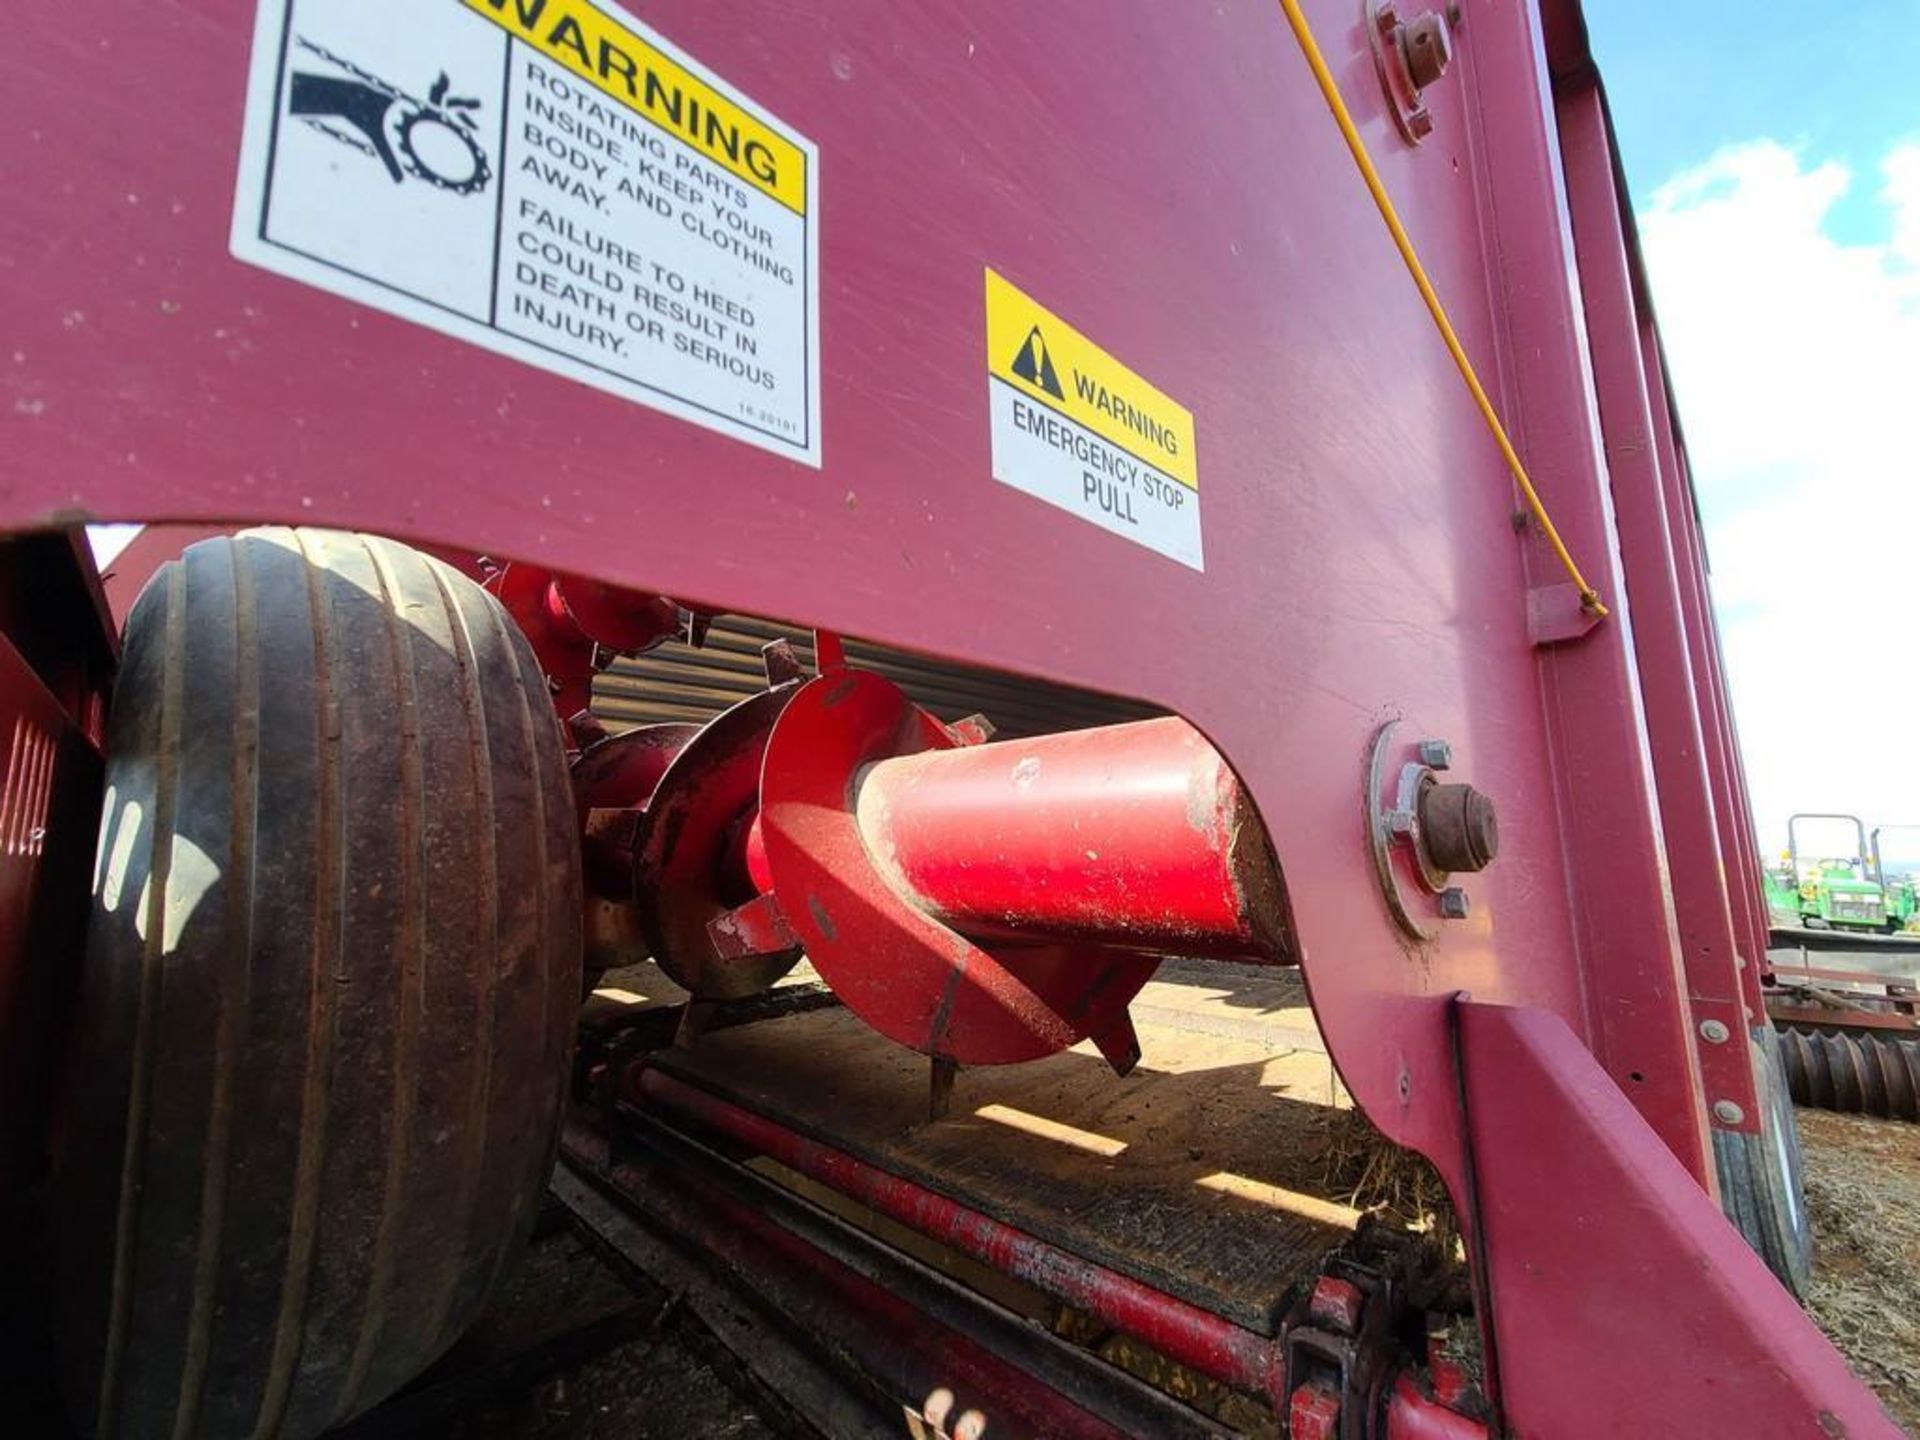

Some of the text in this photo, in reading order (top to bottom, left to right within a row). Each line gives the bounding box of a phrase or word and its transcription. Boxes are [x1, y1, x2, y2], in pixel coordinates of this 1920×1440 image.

[521, 155, 611, 215] AWAY.
[526, 92, 773, 249] INSIDE. KEEP YOUR
[527, 62, 747, 209] ROTATING PARTS
[519, 197, 755, 327] FAILURE TO HEED
[524, 123, 794, 286] BODY AND CLOTHING
[514, 294, 628, 358] INJURY.
[515, 262, 775, 390] DEATH OR SERIOUS
[517, 231, 757, 356] COULD RESULT IN
[1013, 400, 1184, 510] EMERGENCY STOP
[1074, 368, 1178, 456] WARNING
[1083, 473, 1138, 524] PULL
